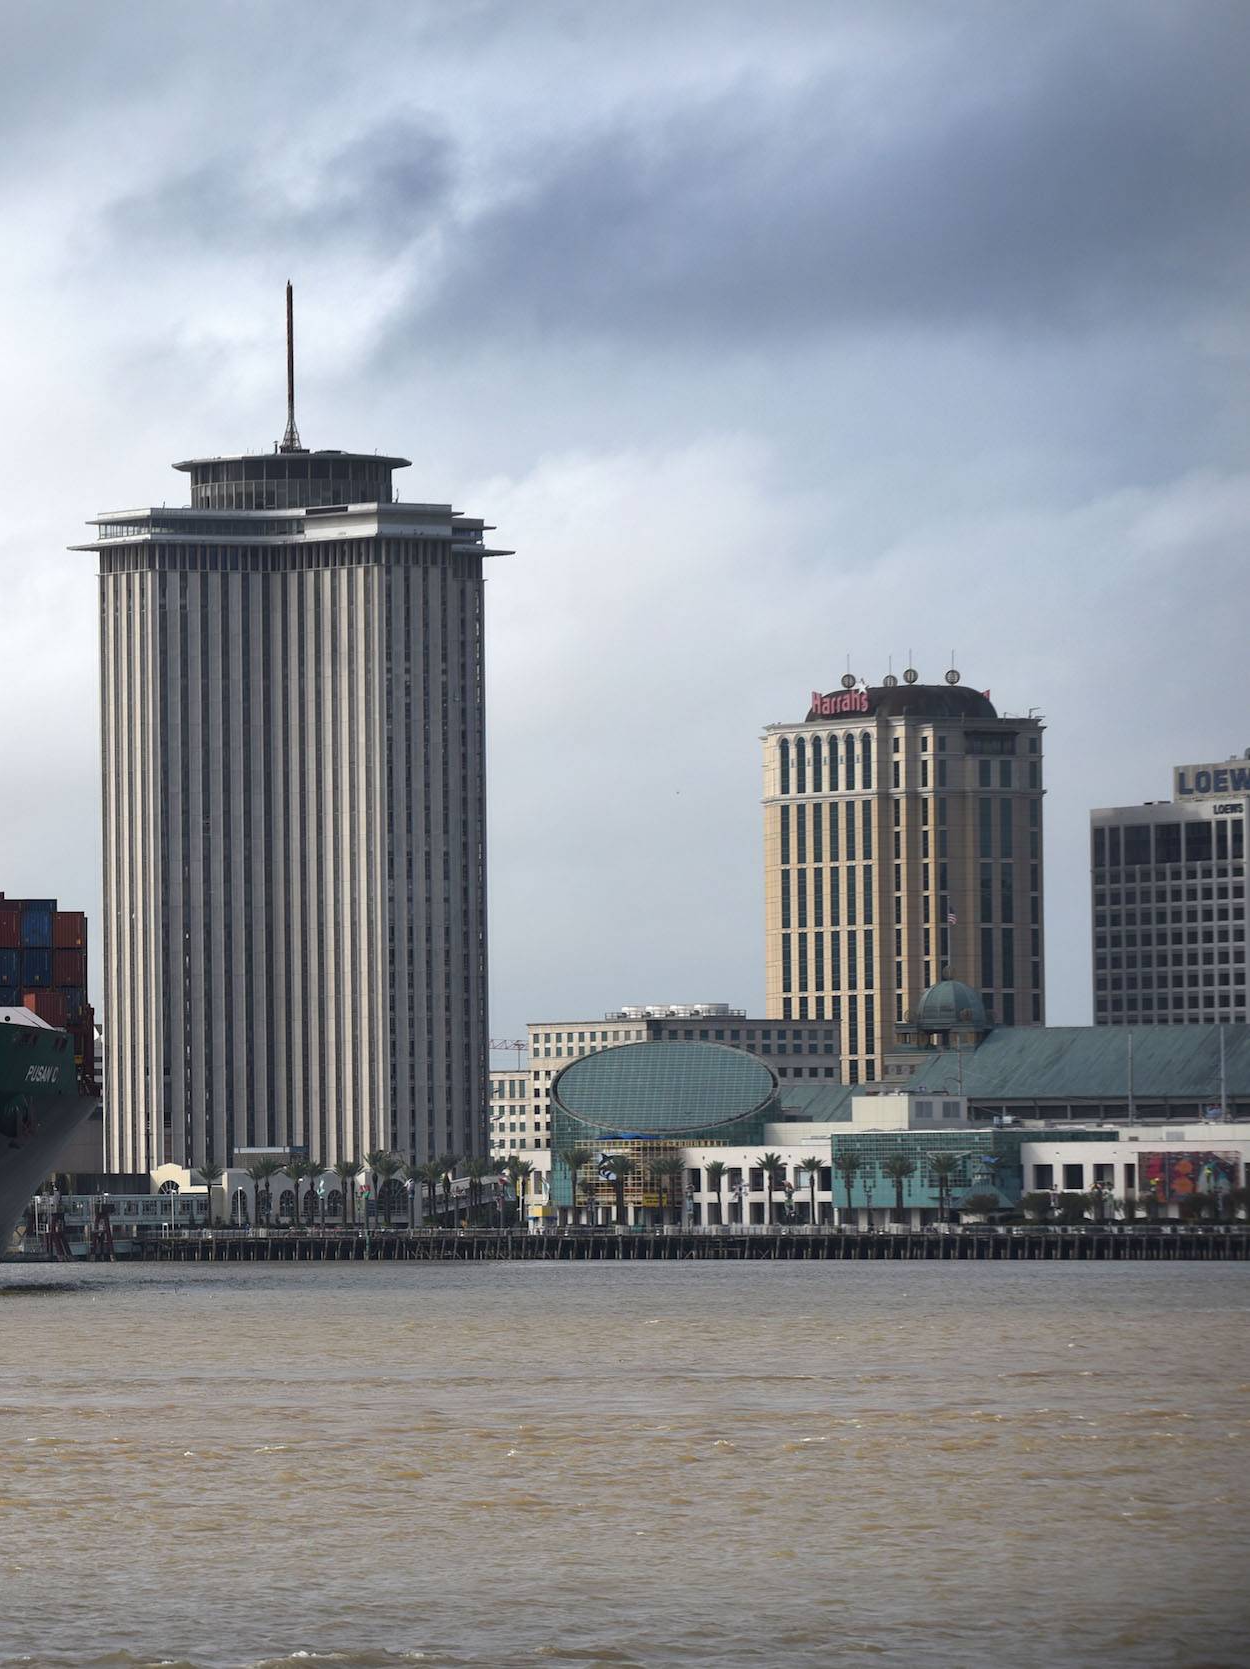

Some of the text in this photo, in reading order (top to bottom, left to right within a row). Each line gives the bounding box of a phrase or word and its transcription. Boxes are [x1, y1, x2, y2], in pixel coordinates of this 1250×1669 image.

[1213, 803, 1244, 815] LOEWS
[24, 1065, 59, 1083] PUSAN C
